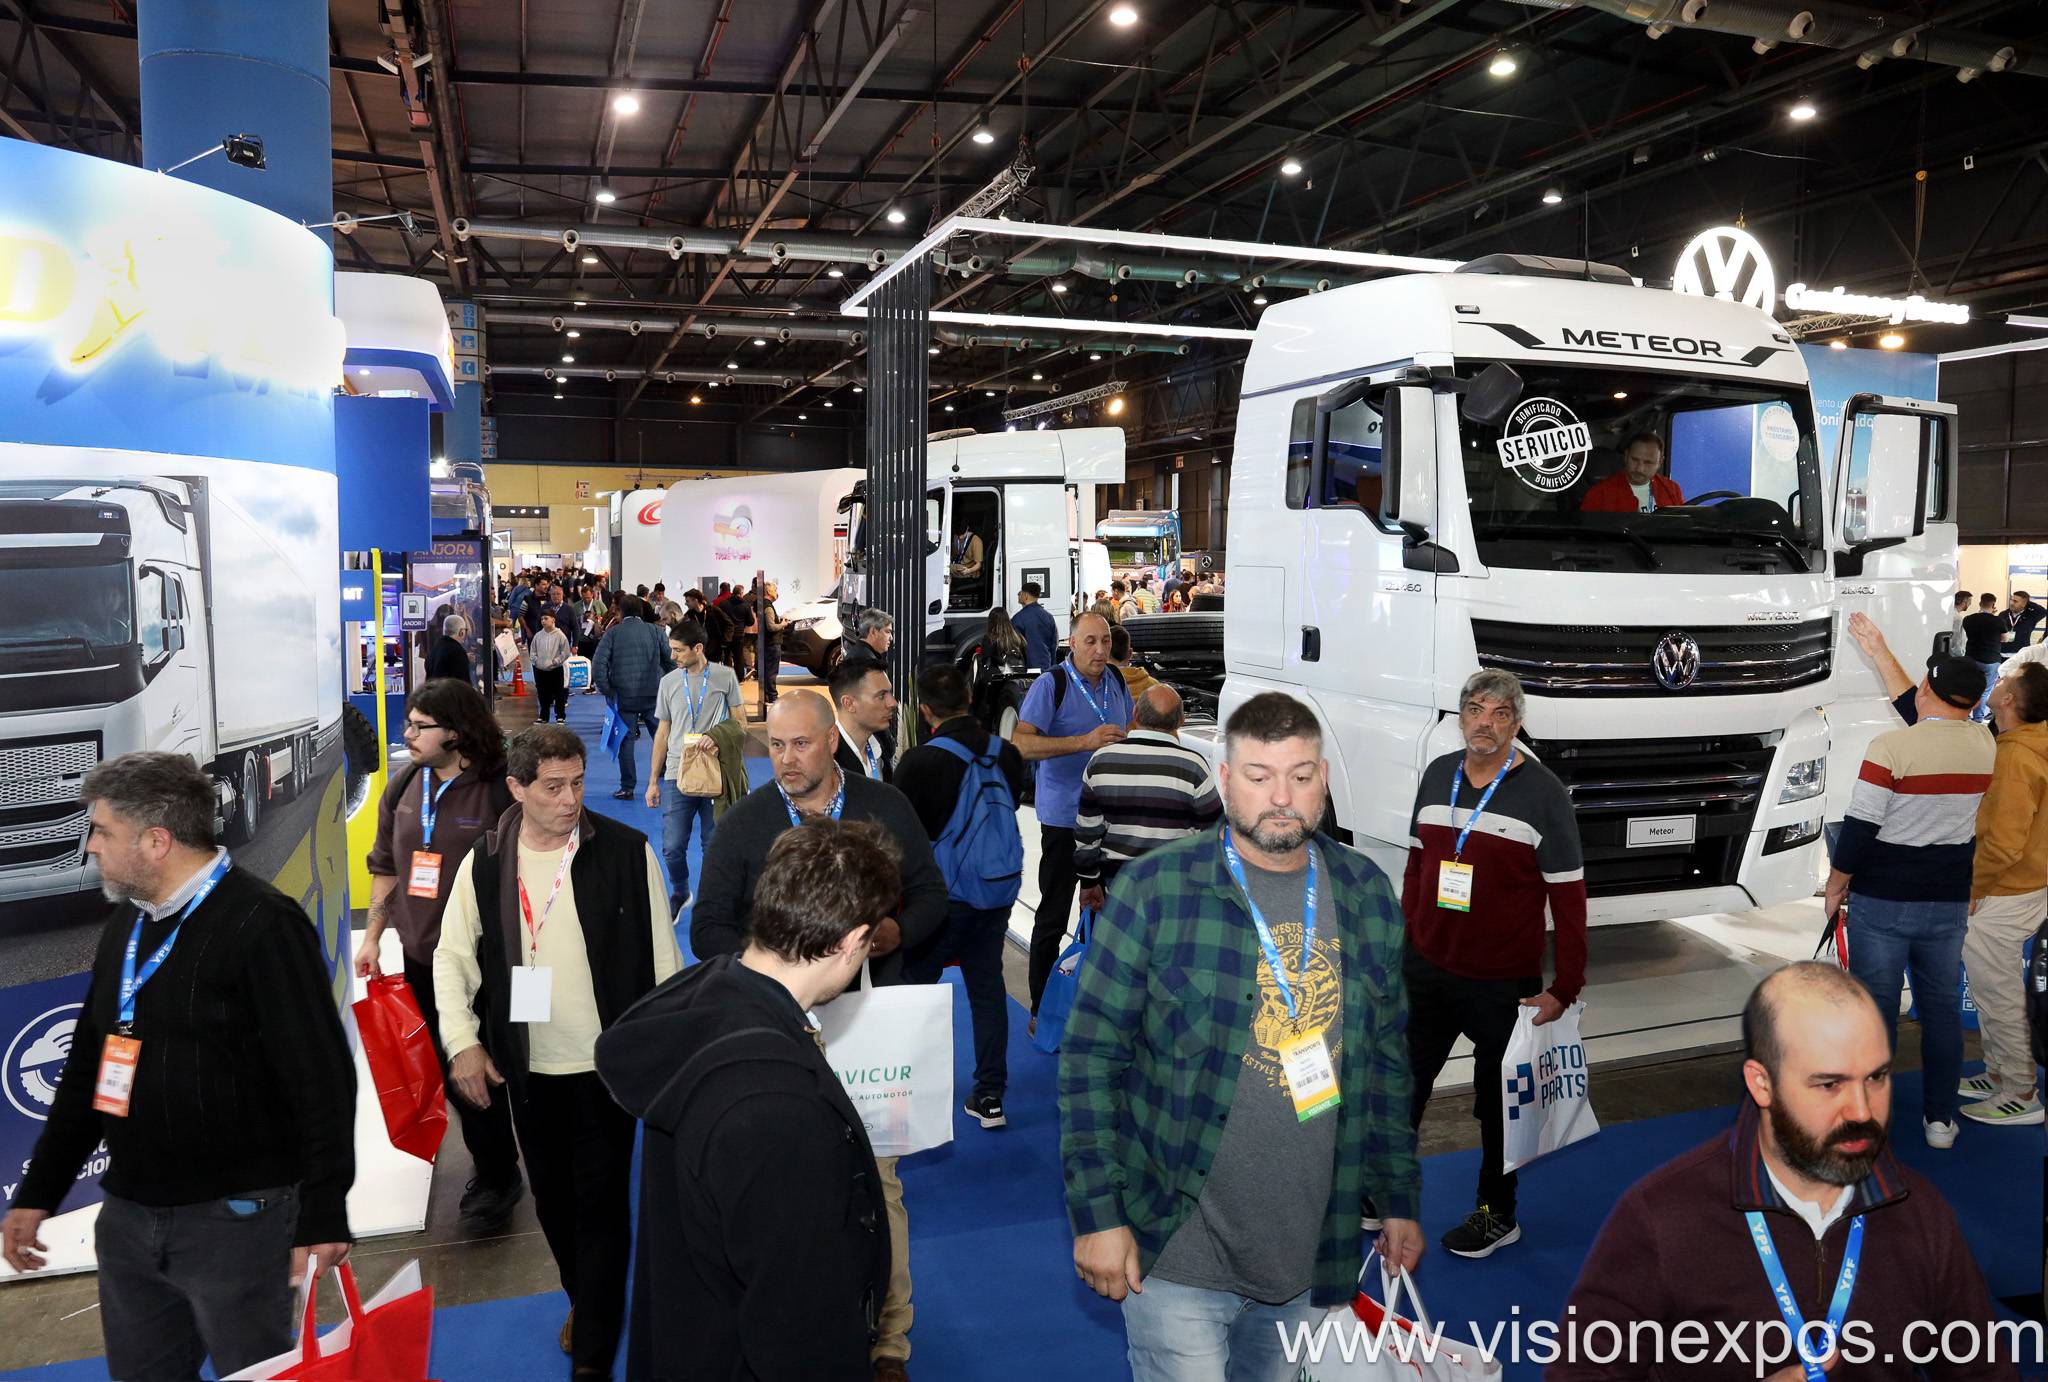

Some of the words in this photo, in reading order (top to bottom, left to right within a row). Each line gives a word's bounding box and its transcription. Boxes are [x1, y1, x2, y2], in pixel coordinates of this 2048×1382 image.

[1561, 327, 1724, 358] METEOR
[1515, 402, 1562, 425] BONIFICADO
[1502, 426, 1587, 463] SERVICIO
[1535, 463, 1578, 488] BONIFICADO
[1747, 611, 1800, 621] METEOR
[1649, 828, 1675, 836] Meteor
[1269, 922, 1319, 937] WESTSE
[150, 943, 171, 963] YPF
[1242, 1054, 1277, 1075] ESTYLE
[1538, 1044, 1587, 1081] FACTO
[859, 1090, 914, 1100] AUTOMOTOR
[1541, 1073, 1586, 1110] PARTS
[1752, 1222, 1773, 1256] YPF
[1840, 1257, 1856, 1291] YPF
[1776, 1282, 1796, 1317] YPF
